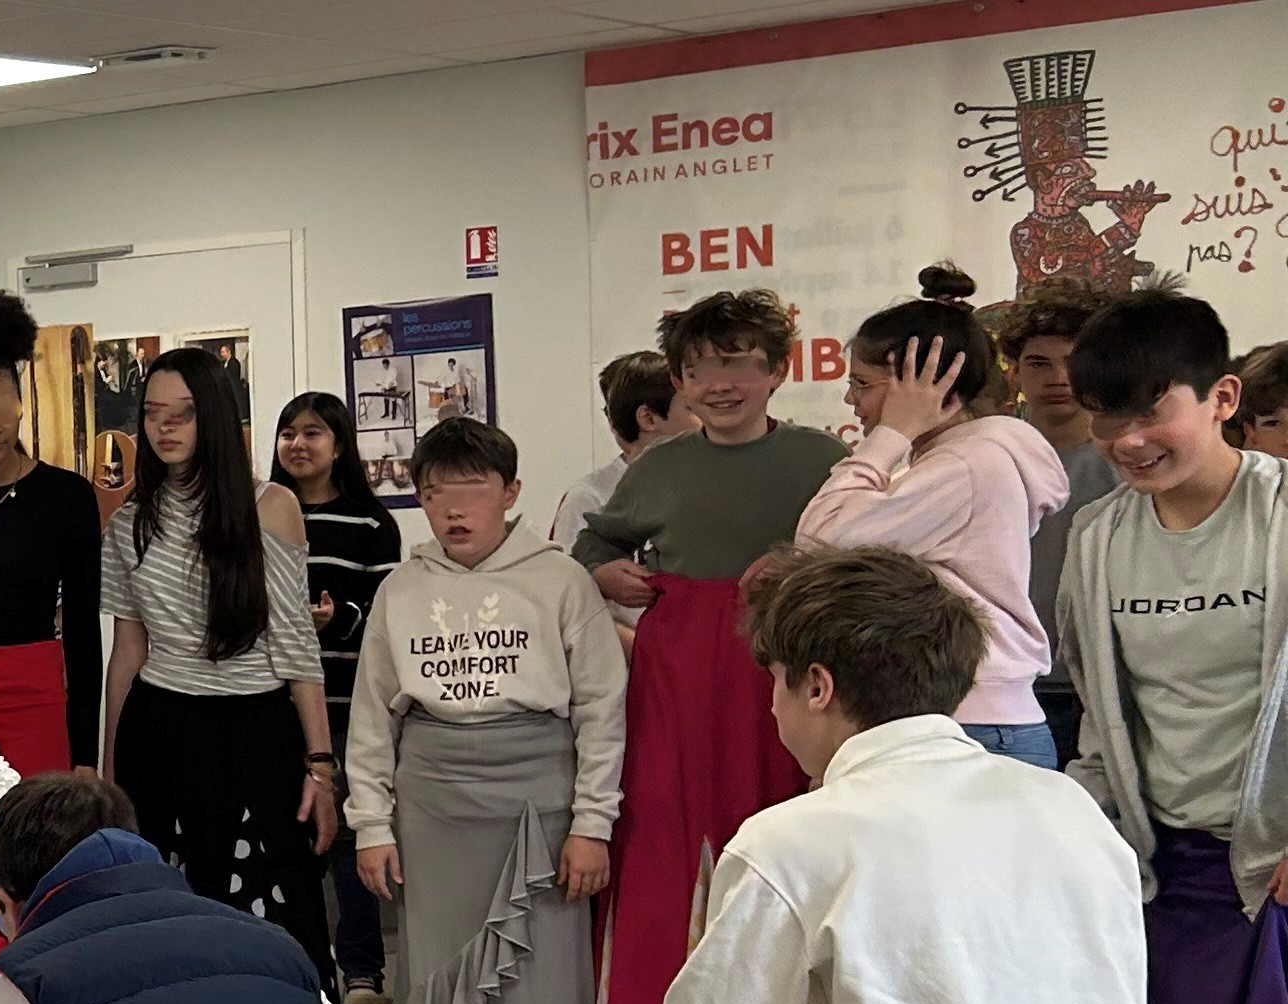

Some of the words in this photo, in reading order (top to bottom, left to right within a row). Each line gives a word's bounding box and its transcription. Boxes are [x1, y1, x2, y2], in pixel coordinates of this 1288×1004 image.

[652, 112, 773, 154] Enea
[589, 165, 666, 189] ORAIN
[674, 153, 774, 180] ANGLET
[1181, 176, 1273, 225] suis
[661, 223, 774, 276] BEN
[1112, 586, 1266, 614] JORDAN
[410, 633, 470, 655] LEAVE
[474, 629, 529, 650] YOUR
[420, 654, 519, 678] COMFORT
[439, 681, 500, 701] ZONE.
